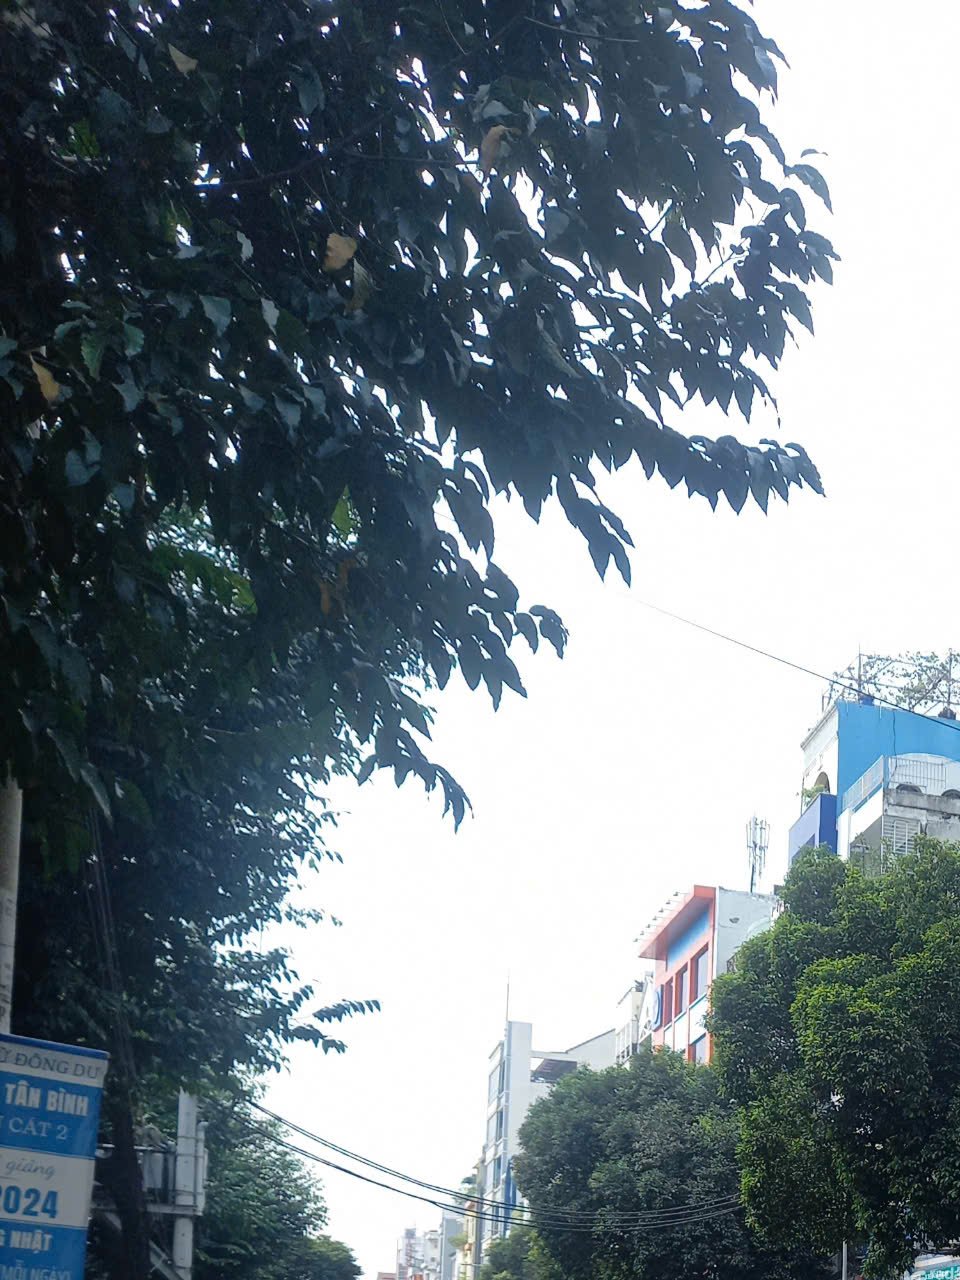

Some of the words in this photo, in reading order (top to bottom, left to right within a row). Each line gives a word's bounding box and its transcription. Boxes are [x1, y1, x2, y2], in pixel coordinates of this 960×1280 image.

[5, 1080, 41, 1109] TÂN
[46, 1087, 89, 1117] BÌNH
[56, 1124, 68, 1140] 2
[0, 1185, 58, 1219] 024
[10, 1230, 52, 1254] NHẬT
